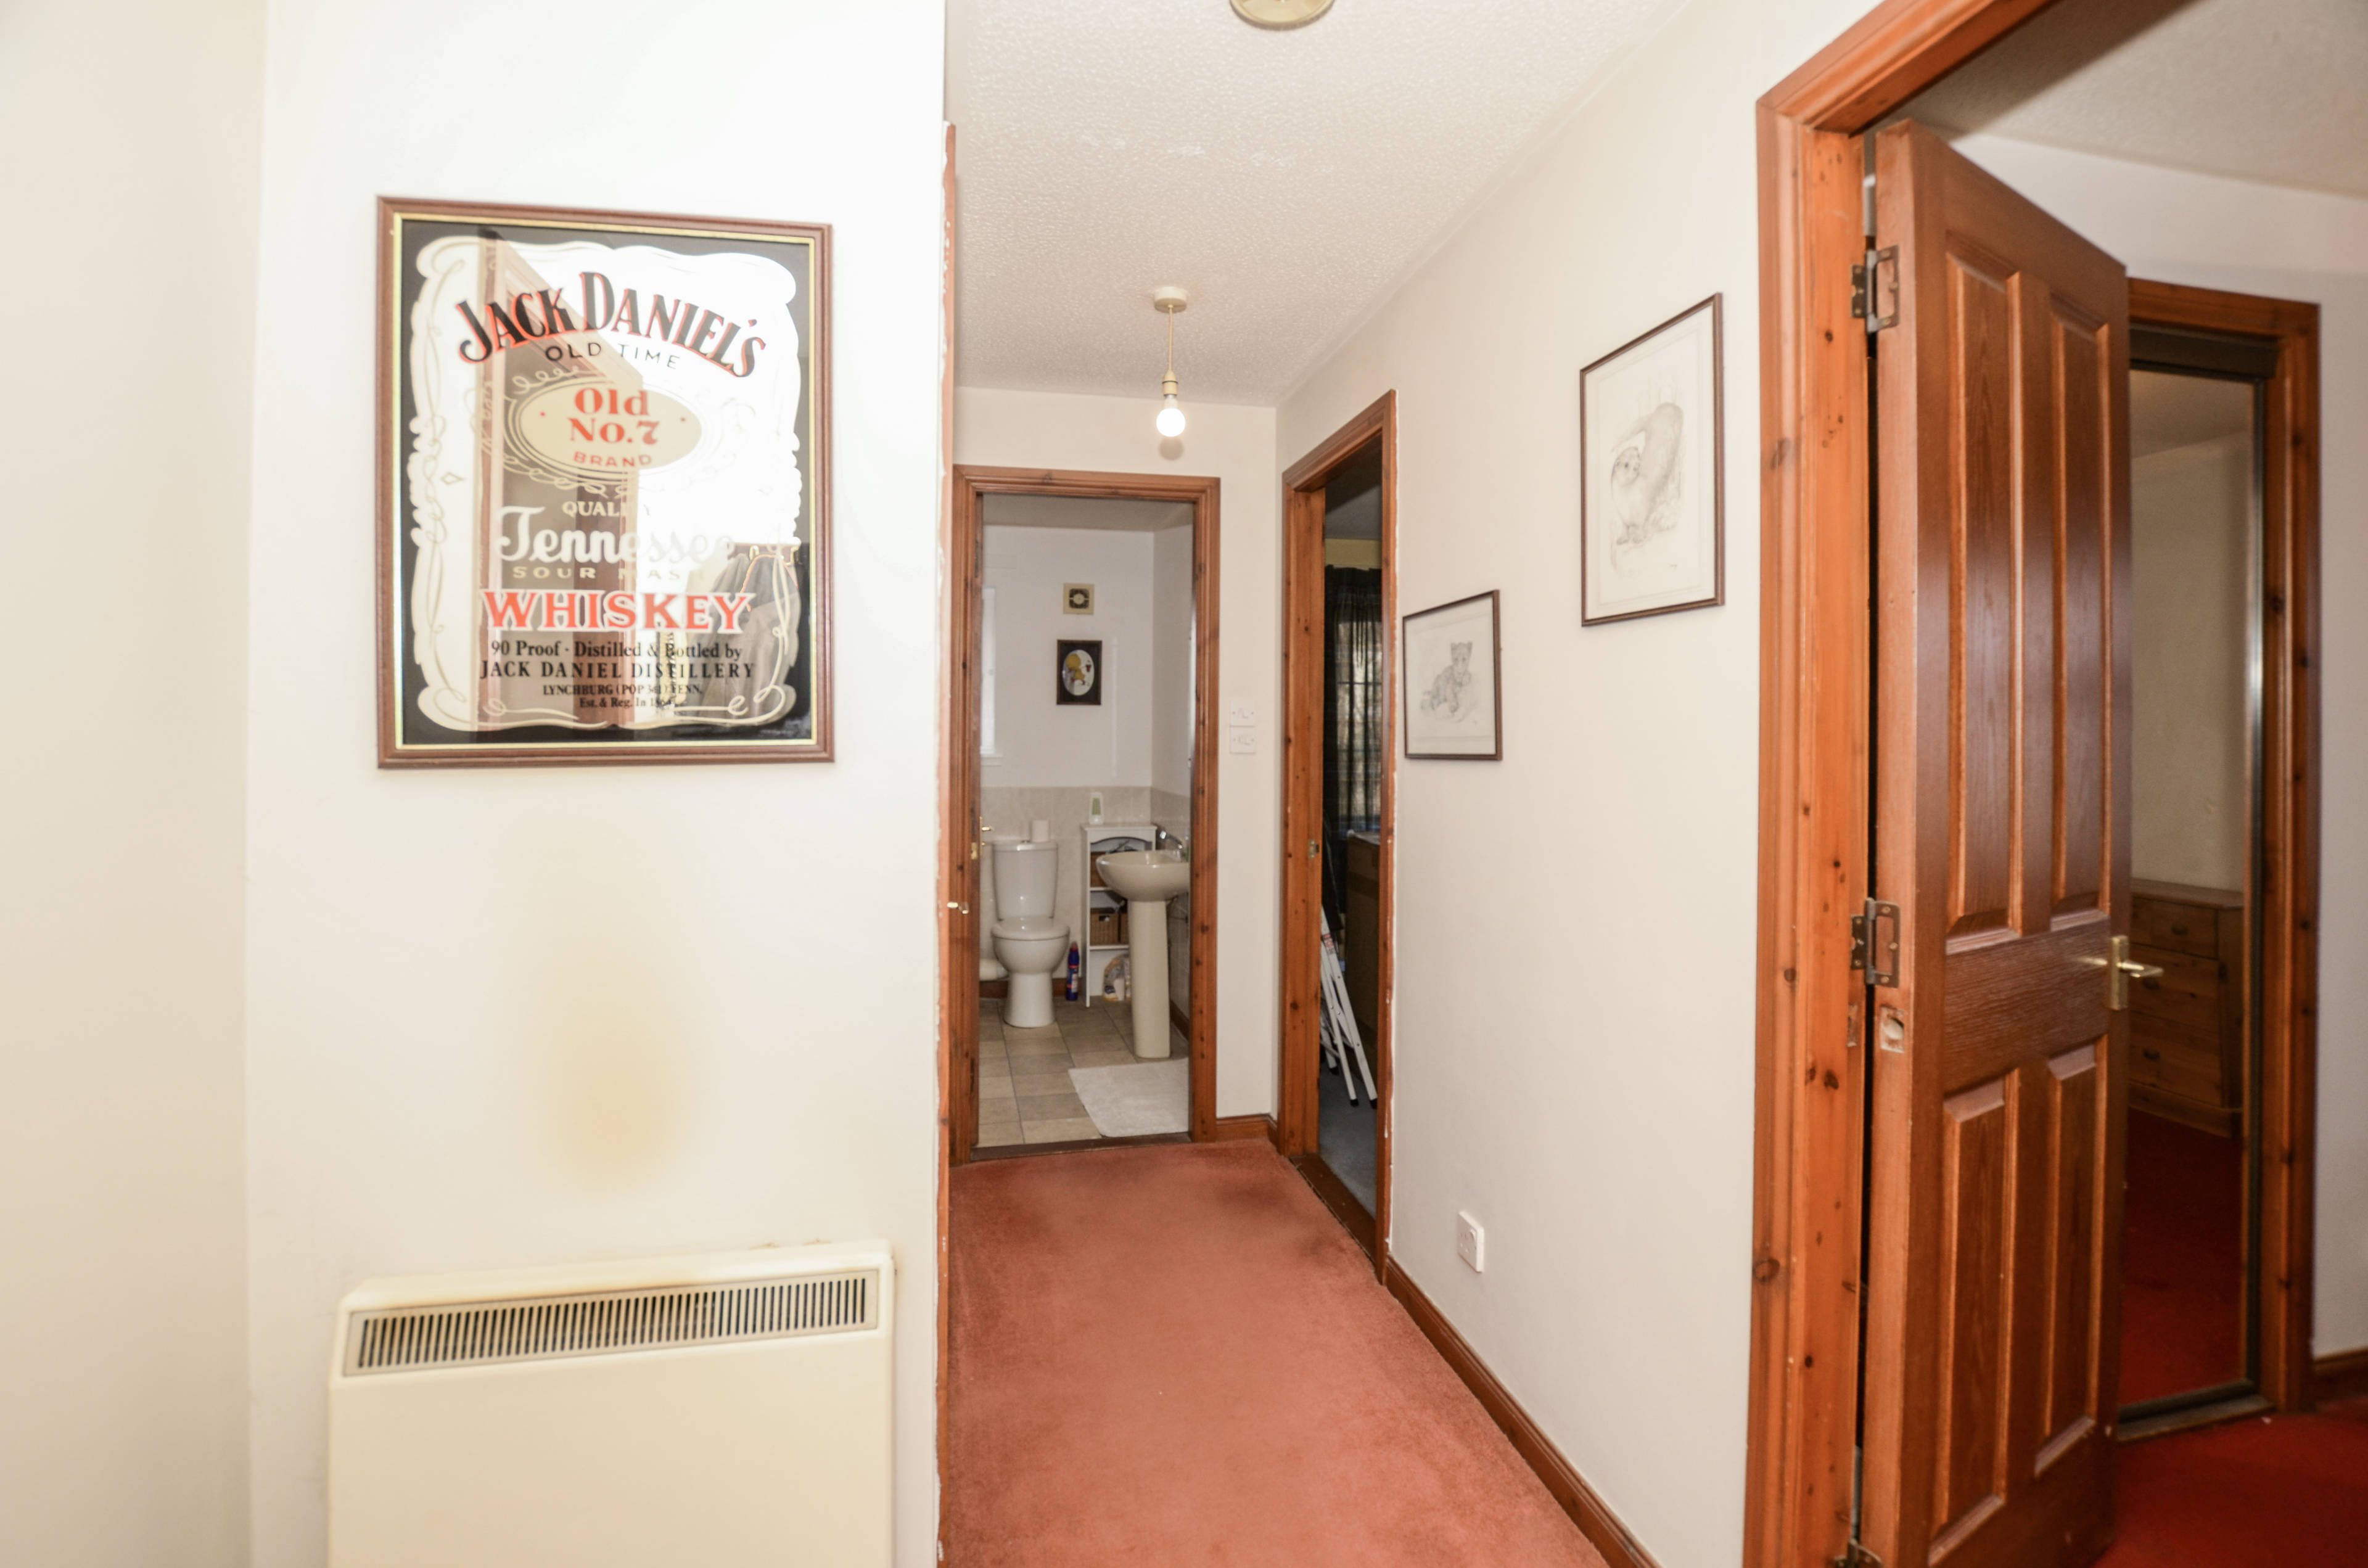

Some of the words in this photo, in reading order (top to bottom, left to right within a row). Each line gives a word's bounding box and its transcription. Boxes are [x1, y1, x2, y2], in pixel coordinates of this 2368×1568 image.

[455, 287, 578, 364] JACK
[579, 271, 766, 377] DANIEL'S
[545, 342, 602, 362] OLD
[618, 343, 680, 370] TIME
[574, 387, 649, 416] Old
[574, 451, 652, 467] BRAND
[562, 501, 652, 517] QUALIY
[493, 506, 735, 565] Tennessee
[512, 567, 597, 580] SOUR
[618, 568, 705, 581] AS
[480, 589, 755, 634] WHISKEY
[491, 640, 510, 657] 90
[516, 640, 562, 657] Proof
[574, 641, 642, 658] Distilled
[647, 642, 659, 657] &
[665, 642, 720, 659] Bottled
[725, 643, 742, 662] by
[481, 660, 531, 679] JACK
[540, 661, 623, 679] DANIEL
[631, 663, 754, 679] DISTILLERY
[542, 684, 614, 696] LYNCHBURG
